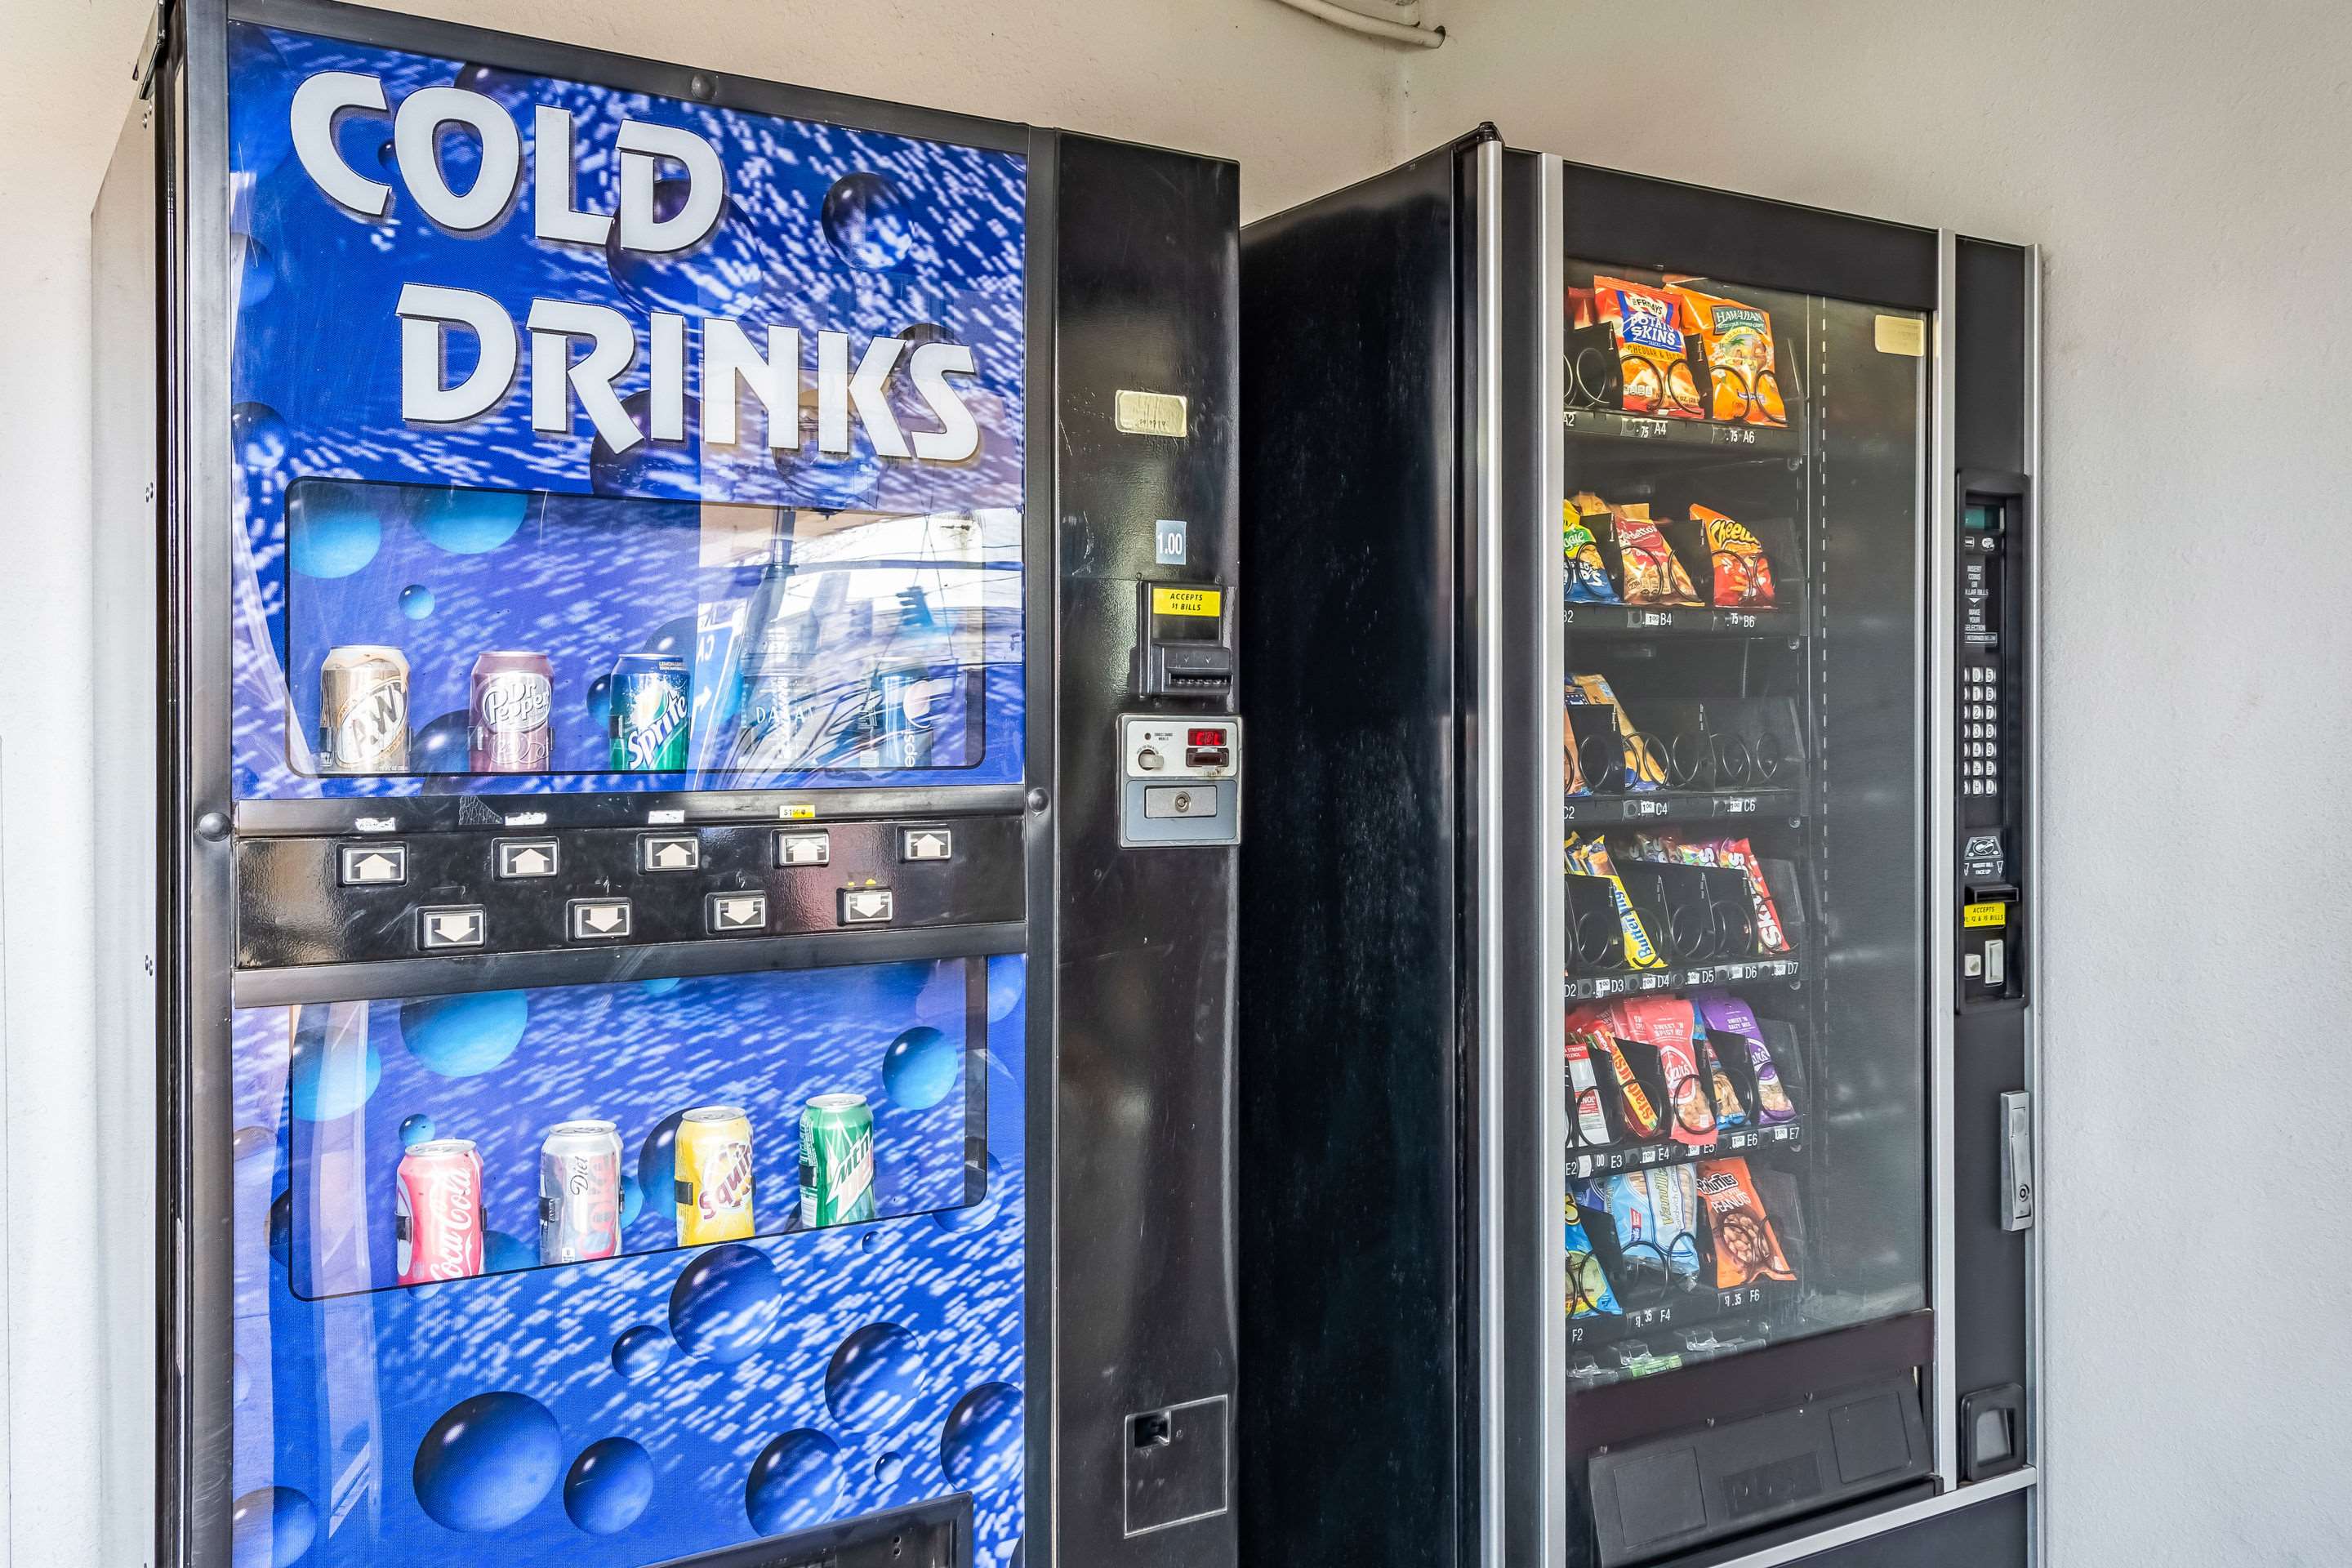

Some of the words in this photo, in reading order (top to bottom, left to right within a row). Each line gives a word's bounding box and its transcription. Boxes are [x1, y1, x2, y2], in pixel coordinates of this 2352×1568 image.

[289, 70, 725, 253] COLD
[1716, 310, 1764, 323] HAWAIIAN
[1631, 325, 1676, 346] SKINS
[1628, 345, 1656, 355] CHEDDAR
[396, 282, 980, 460] DRINKS
[1654, 421, 1667, 434] A4
[1743, 430, 1755, 443] A6
[1157, 532, 1183, 555] 1.00
[1170, 592, 1203, 601] ACCEPTS
[1181, 603, 1201, 612] BILLS
[1660, 612, 1672, 626] B4
[1744, 615, 1755, 628] B6
[510, 677, 537, 706] Dr
[485, 686, 550, 725] Pepper
[628, 687, 688, 770] Sprite
[903, 729, 918, 767] epsi
[1655, 802, 1668, 816] C4
[1744, 799, 1756, 812] C6
[1745, 966, 1757, 978] D6
[1788, 961, 1799, 974] D7
[1657, 975, 1670, 988] D4
[1702, 970, 1714, 983] D5
[1611, 979, 1624, 993] D3
[1747, 1133, 1758, 1147] E6
[1789, 1126, 1800, 1140] E7
[1658, 1147, 1670, 1160] E4
[1704, 1143, 1715, 1154] E5
[1566, 1161, 1577, 1176] E2
[1610, 1154, 1623, 1169] E3
[570, 1156, 588, 1195] Diet
[1712, 1192, 1751, 1214] PEANUTS
[1749, 1290, 1760, 1303] F6
[1659, 1308, 1671, 1323] F4
[1572, 1327, 1584, 1343] F2
